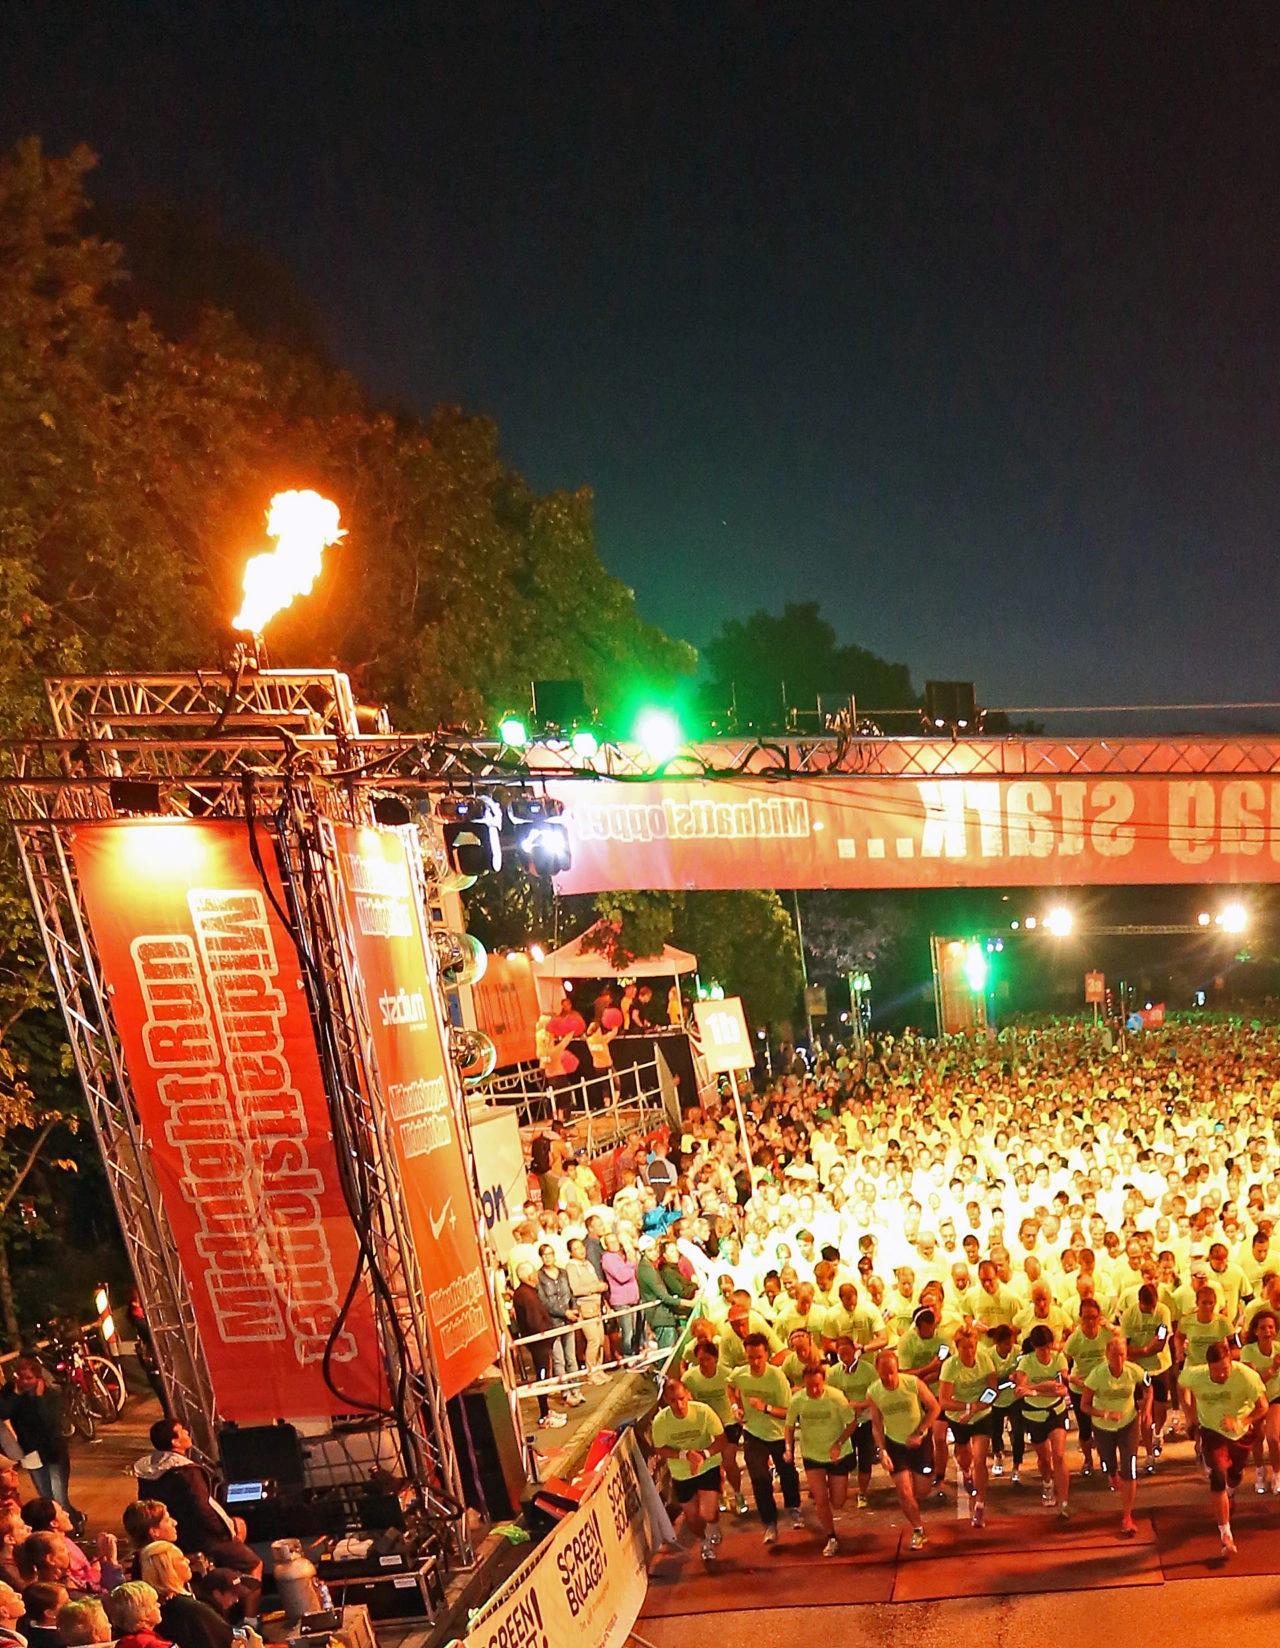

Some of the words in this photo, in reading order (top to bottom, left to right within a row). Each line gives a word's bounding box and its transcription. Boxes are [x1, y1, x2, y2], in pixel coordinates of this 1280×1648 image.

[131, 935, 219, 1068] Run
[187, 888, 358, 1363] Midnattsloppet
[161, 1072, 286, 1342] Midnight
